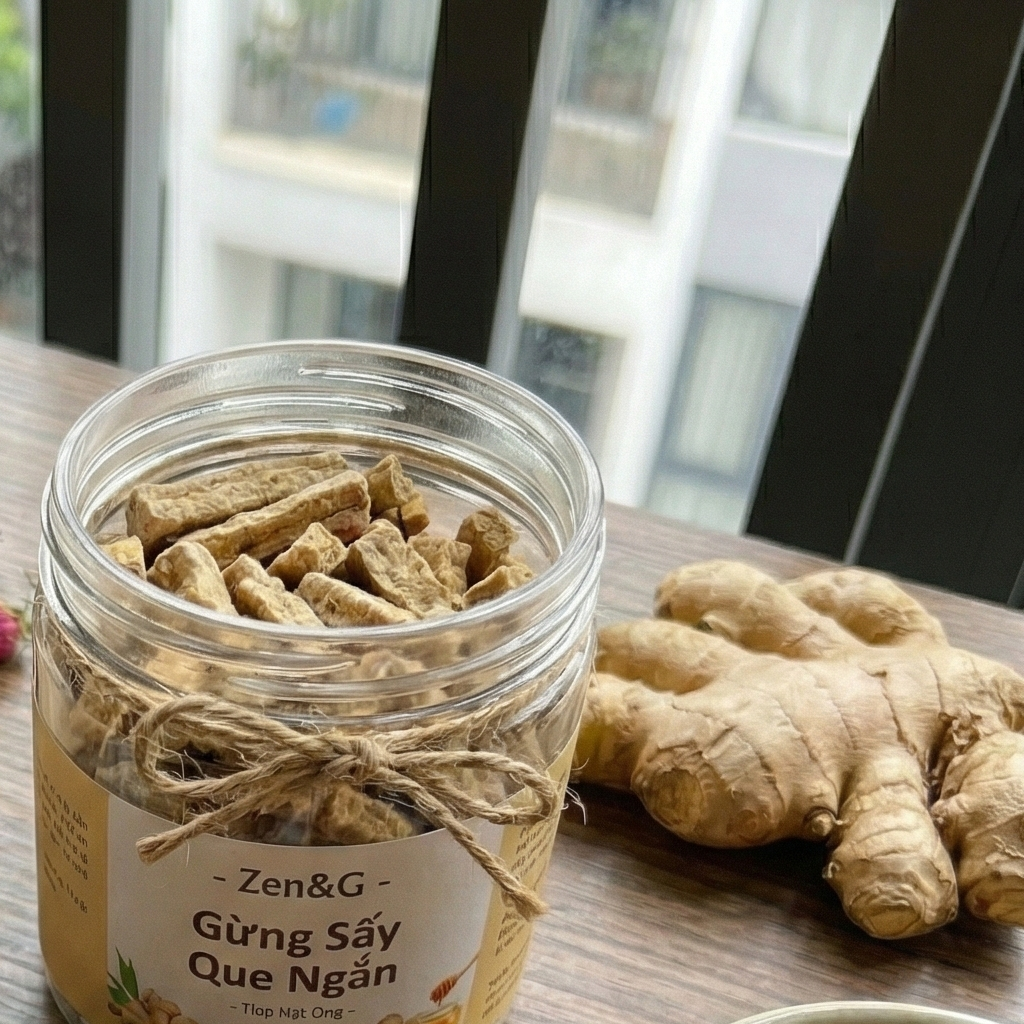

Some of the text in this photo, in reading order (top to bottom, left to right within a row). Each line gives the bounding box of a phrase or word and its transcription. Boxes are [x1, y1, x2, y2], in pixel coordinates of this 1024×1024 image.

[237, 867, 365, 899] Zen&G
[192, 910, 402, 958] Gừng Sấy
[188, 951, 398, 999] Que Ngắn
[311, 1006, 344, 1020] Ong
